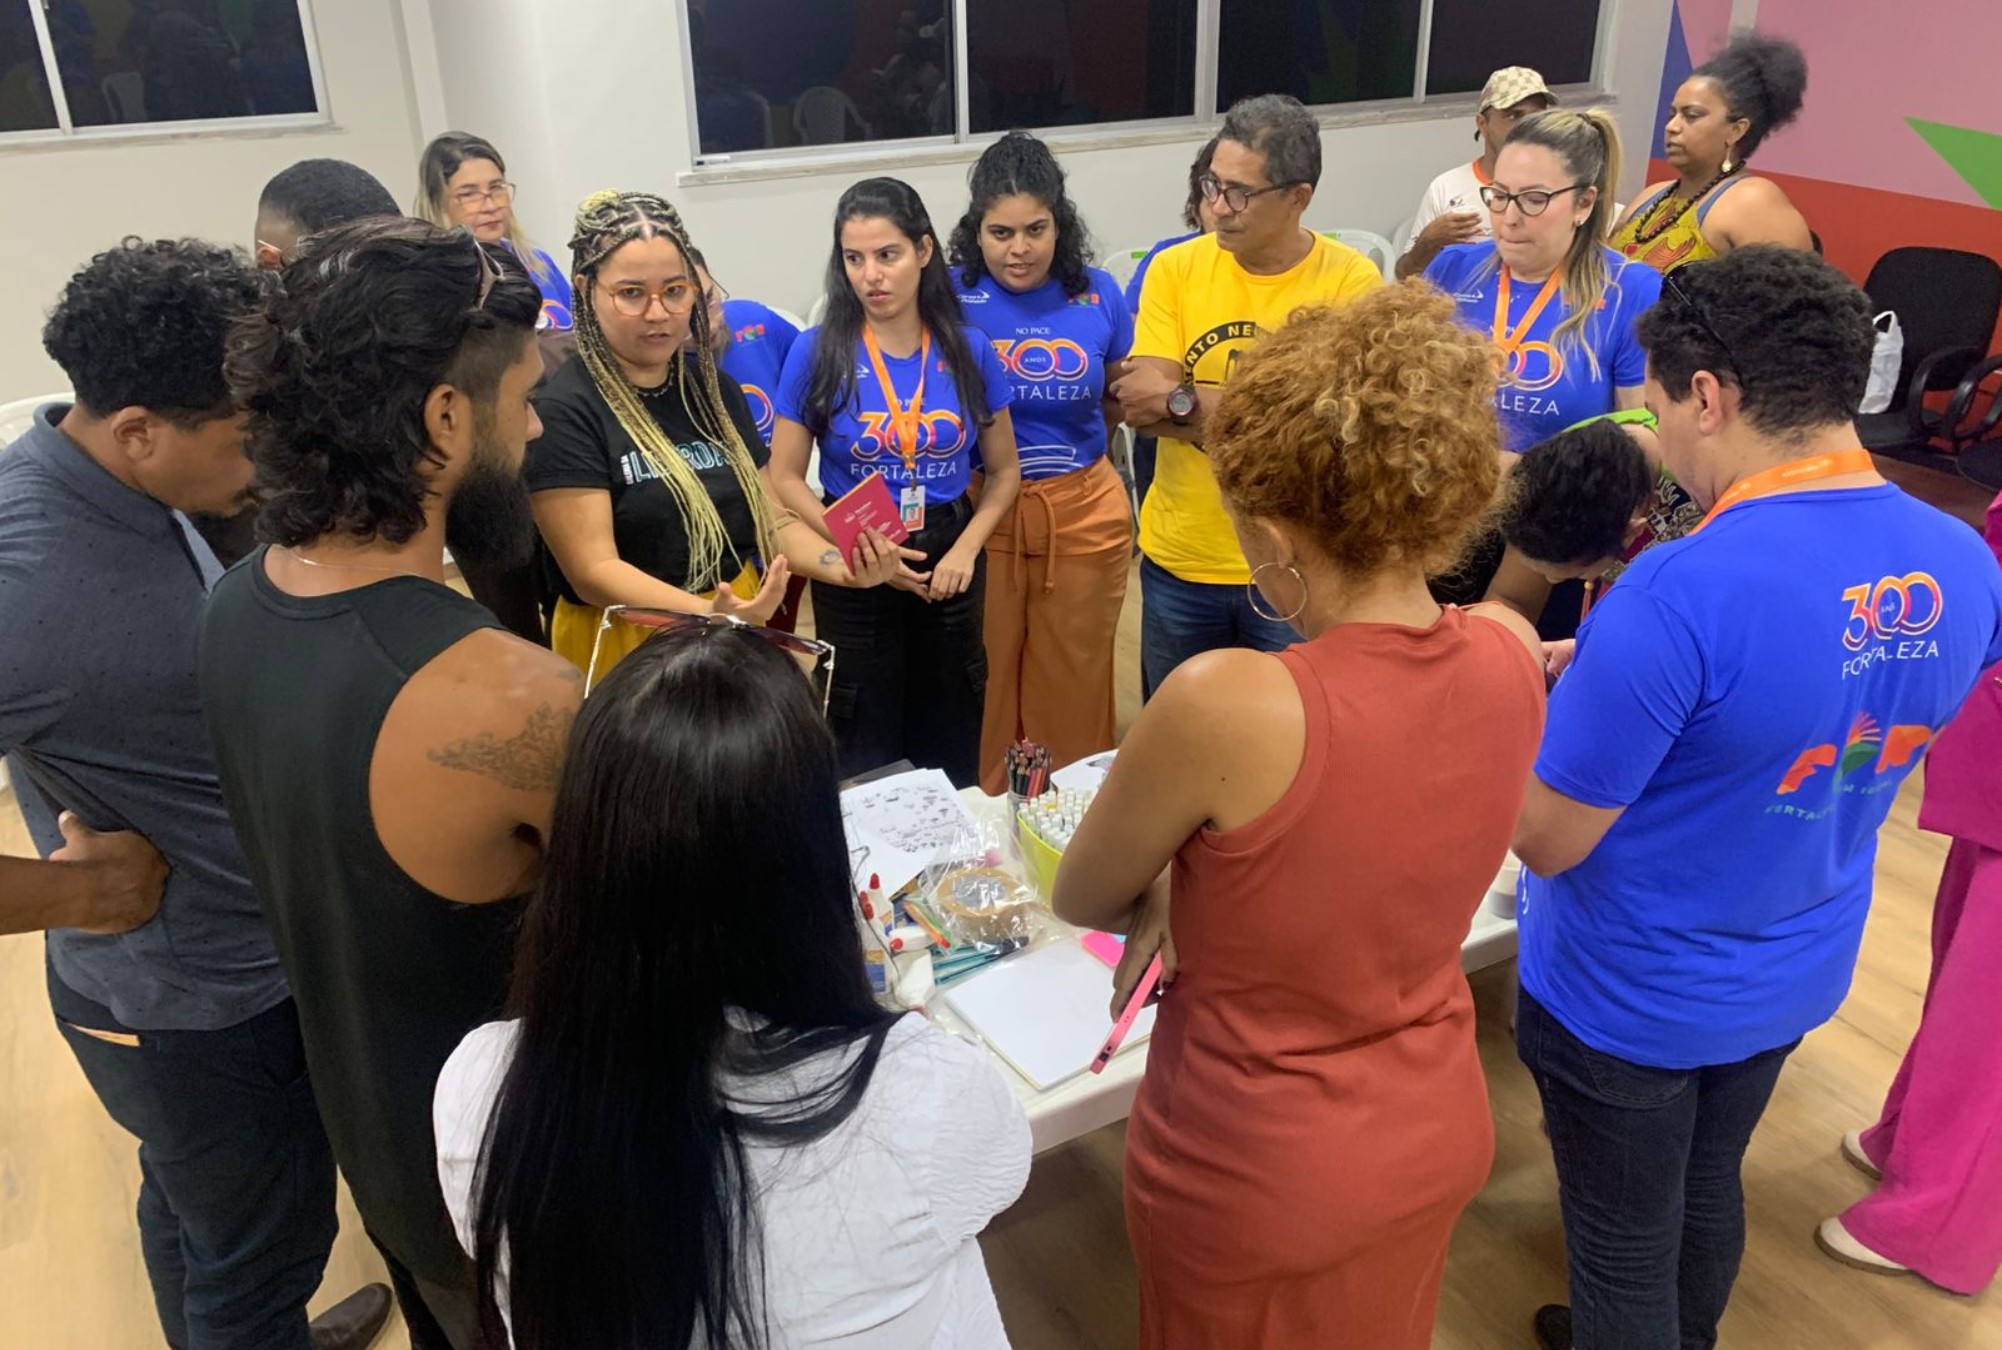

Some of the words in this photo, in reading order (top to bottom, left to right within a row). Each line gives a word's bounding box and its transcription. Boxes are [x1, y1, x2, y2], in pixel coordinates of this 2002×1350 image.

[1015, 327, 1029, 335] NO
[1227, 323, 1256, 338] NE
[1842, 570, 1942, 651] 300
